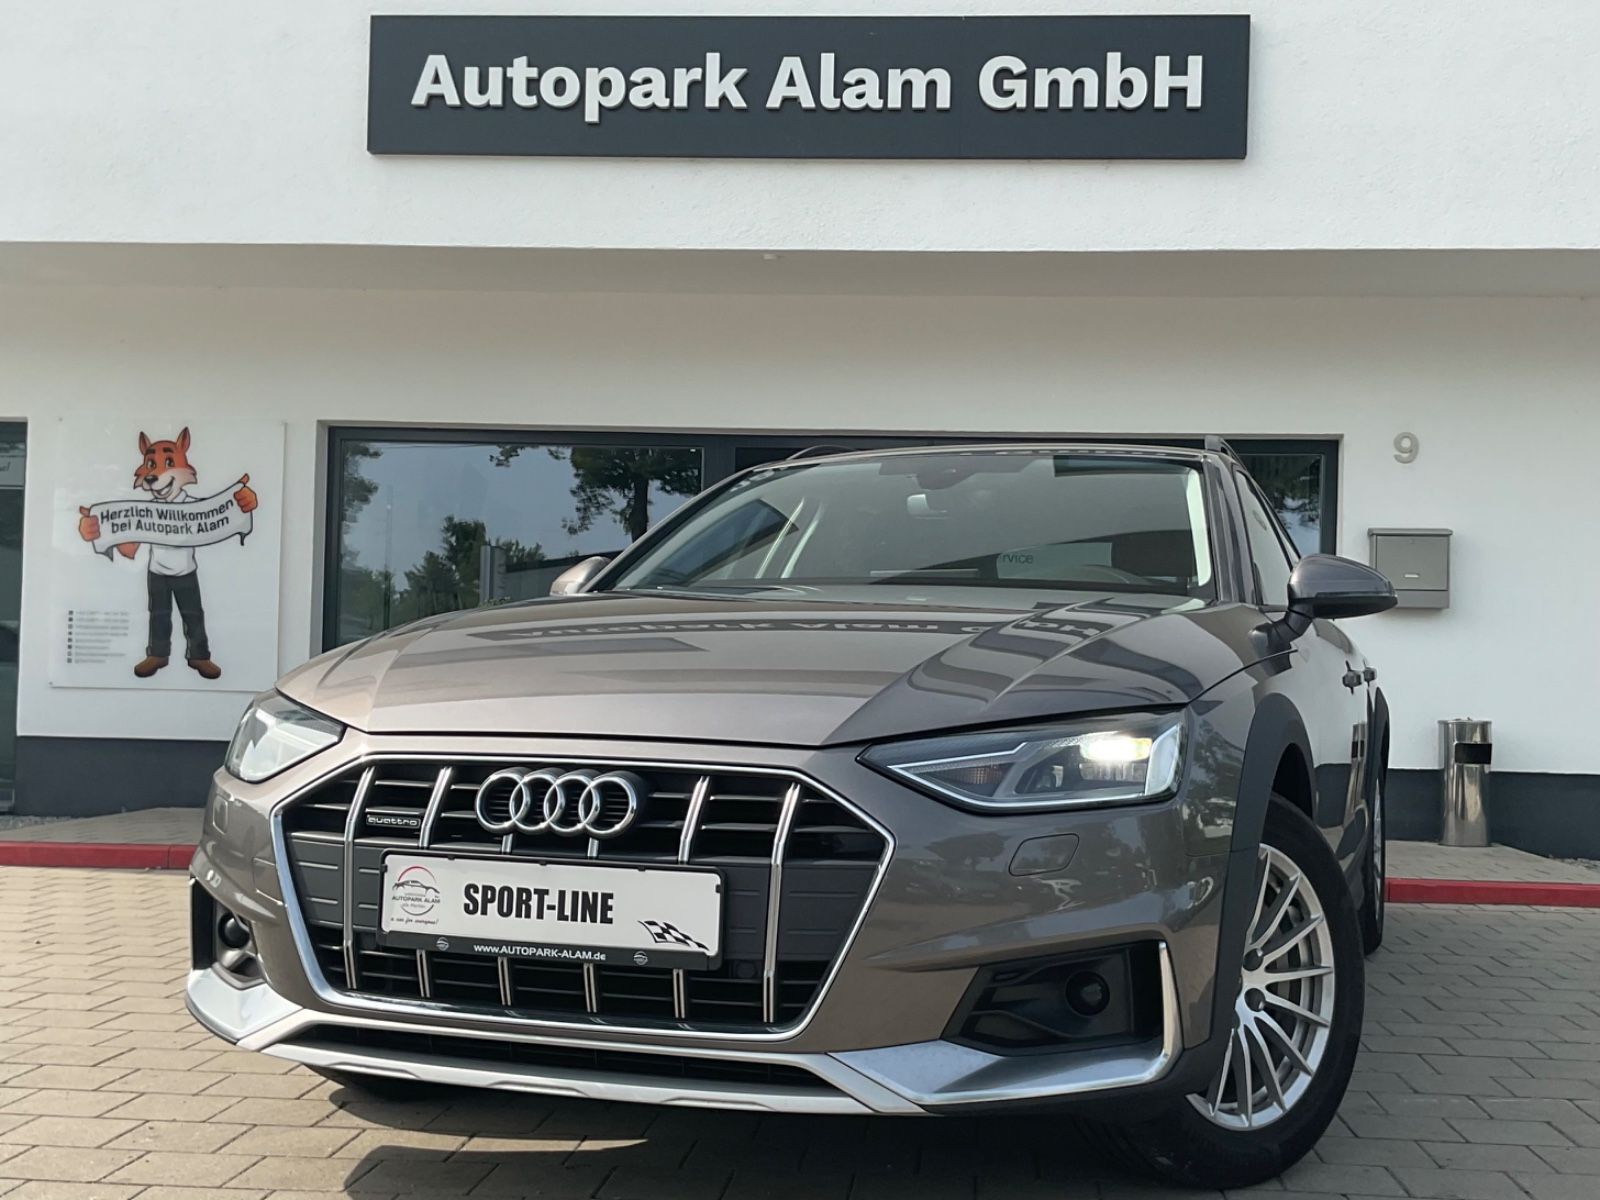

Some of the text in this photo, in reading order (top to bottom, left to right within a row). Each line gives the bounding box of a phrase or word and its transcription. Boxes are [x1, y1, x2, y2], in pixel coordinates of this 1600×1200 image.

[411, 52, 1204, 124] Autopark Alam GmbH
[1393, 431, 1420, 464] 9
[100, 499, 234, 524] Herzlich Willkommen
[111, 516, 229, 536] bei Autopark Alam
[367, 816, 418, 826] quattro
[463, 883, 614, 924] SPORT-LINE
[473, 943, 607, 961] www.AUTOPARK-ALAM.de
